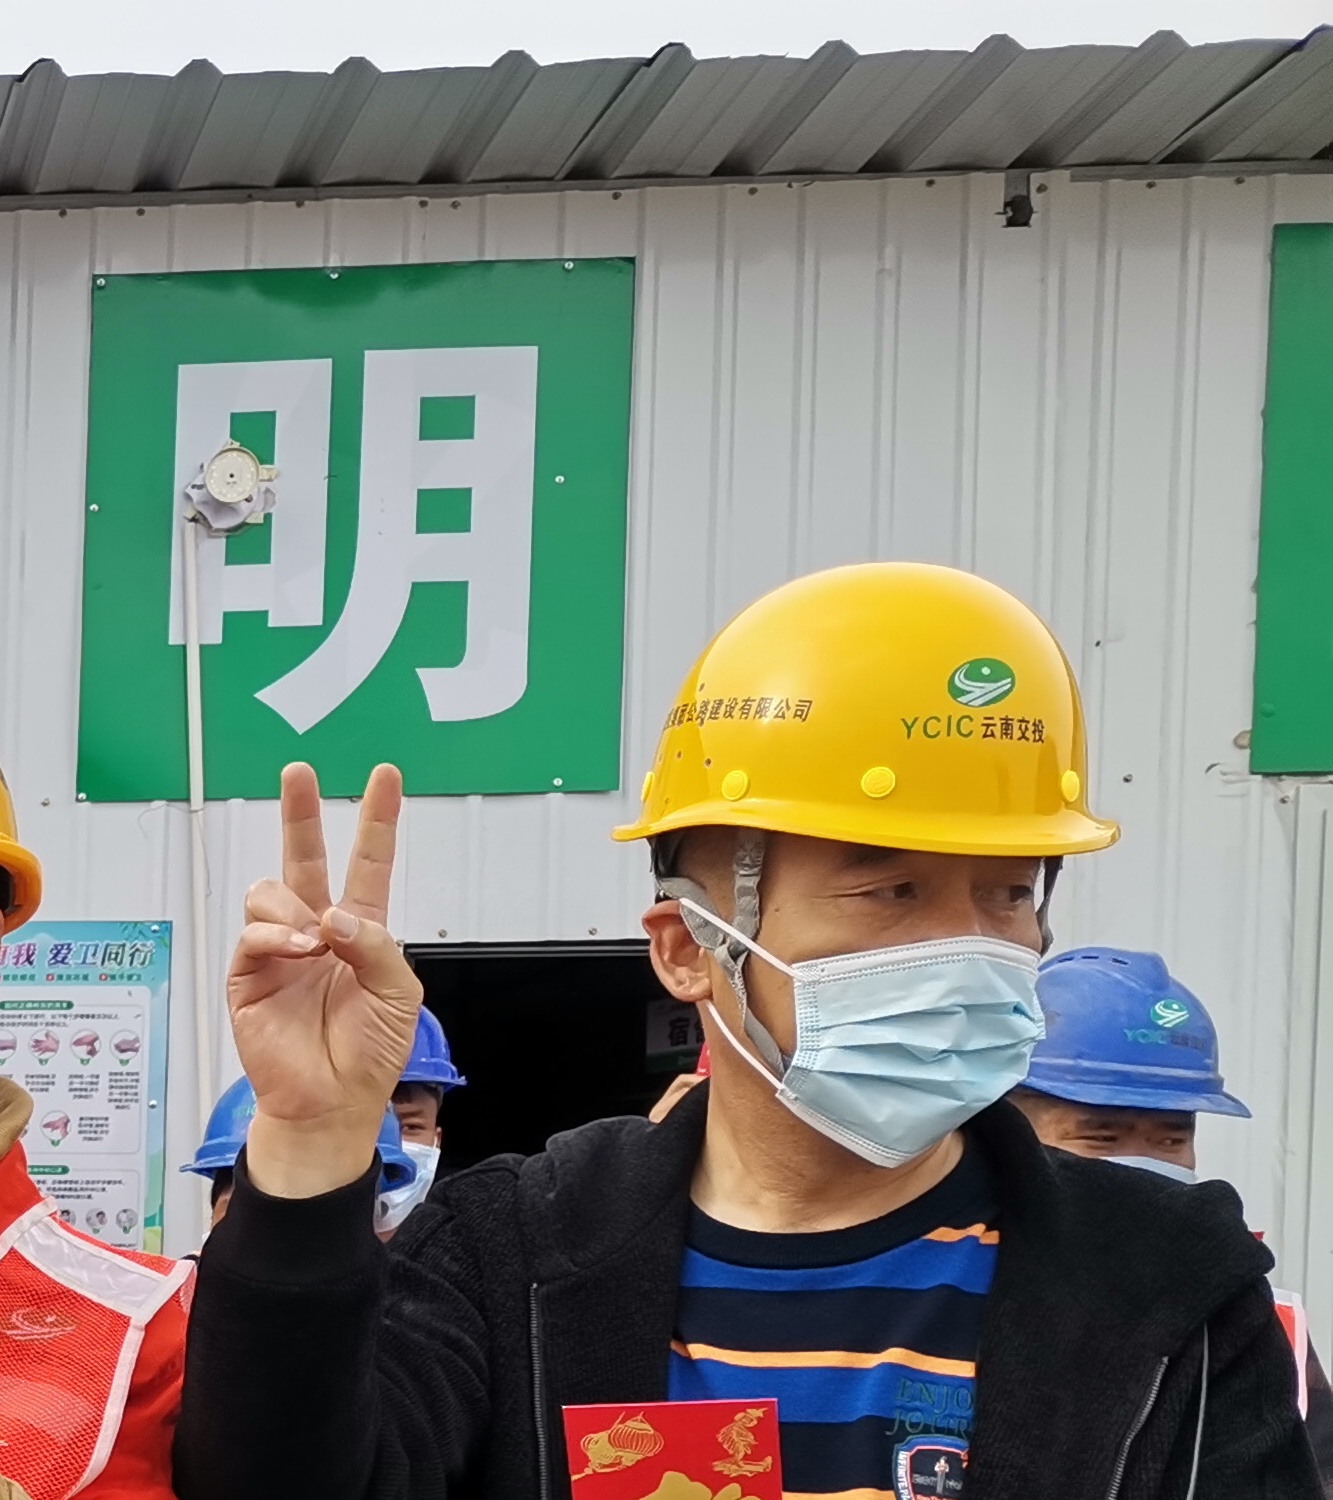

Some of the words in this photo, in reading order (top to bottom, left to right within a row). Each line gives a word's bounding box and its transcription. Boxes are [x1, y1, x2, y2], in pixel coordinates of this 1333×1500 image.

[169, 346, 538, 734] 明
[900, 715, 1045, 743] YCIC云南交投
[47, 942, 156, 967] 爱卫同行
